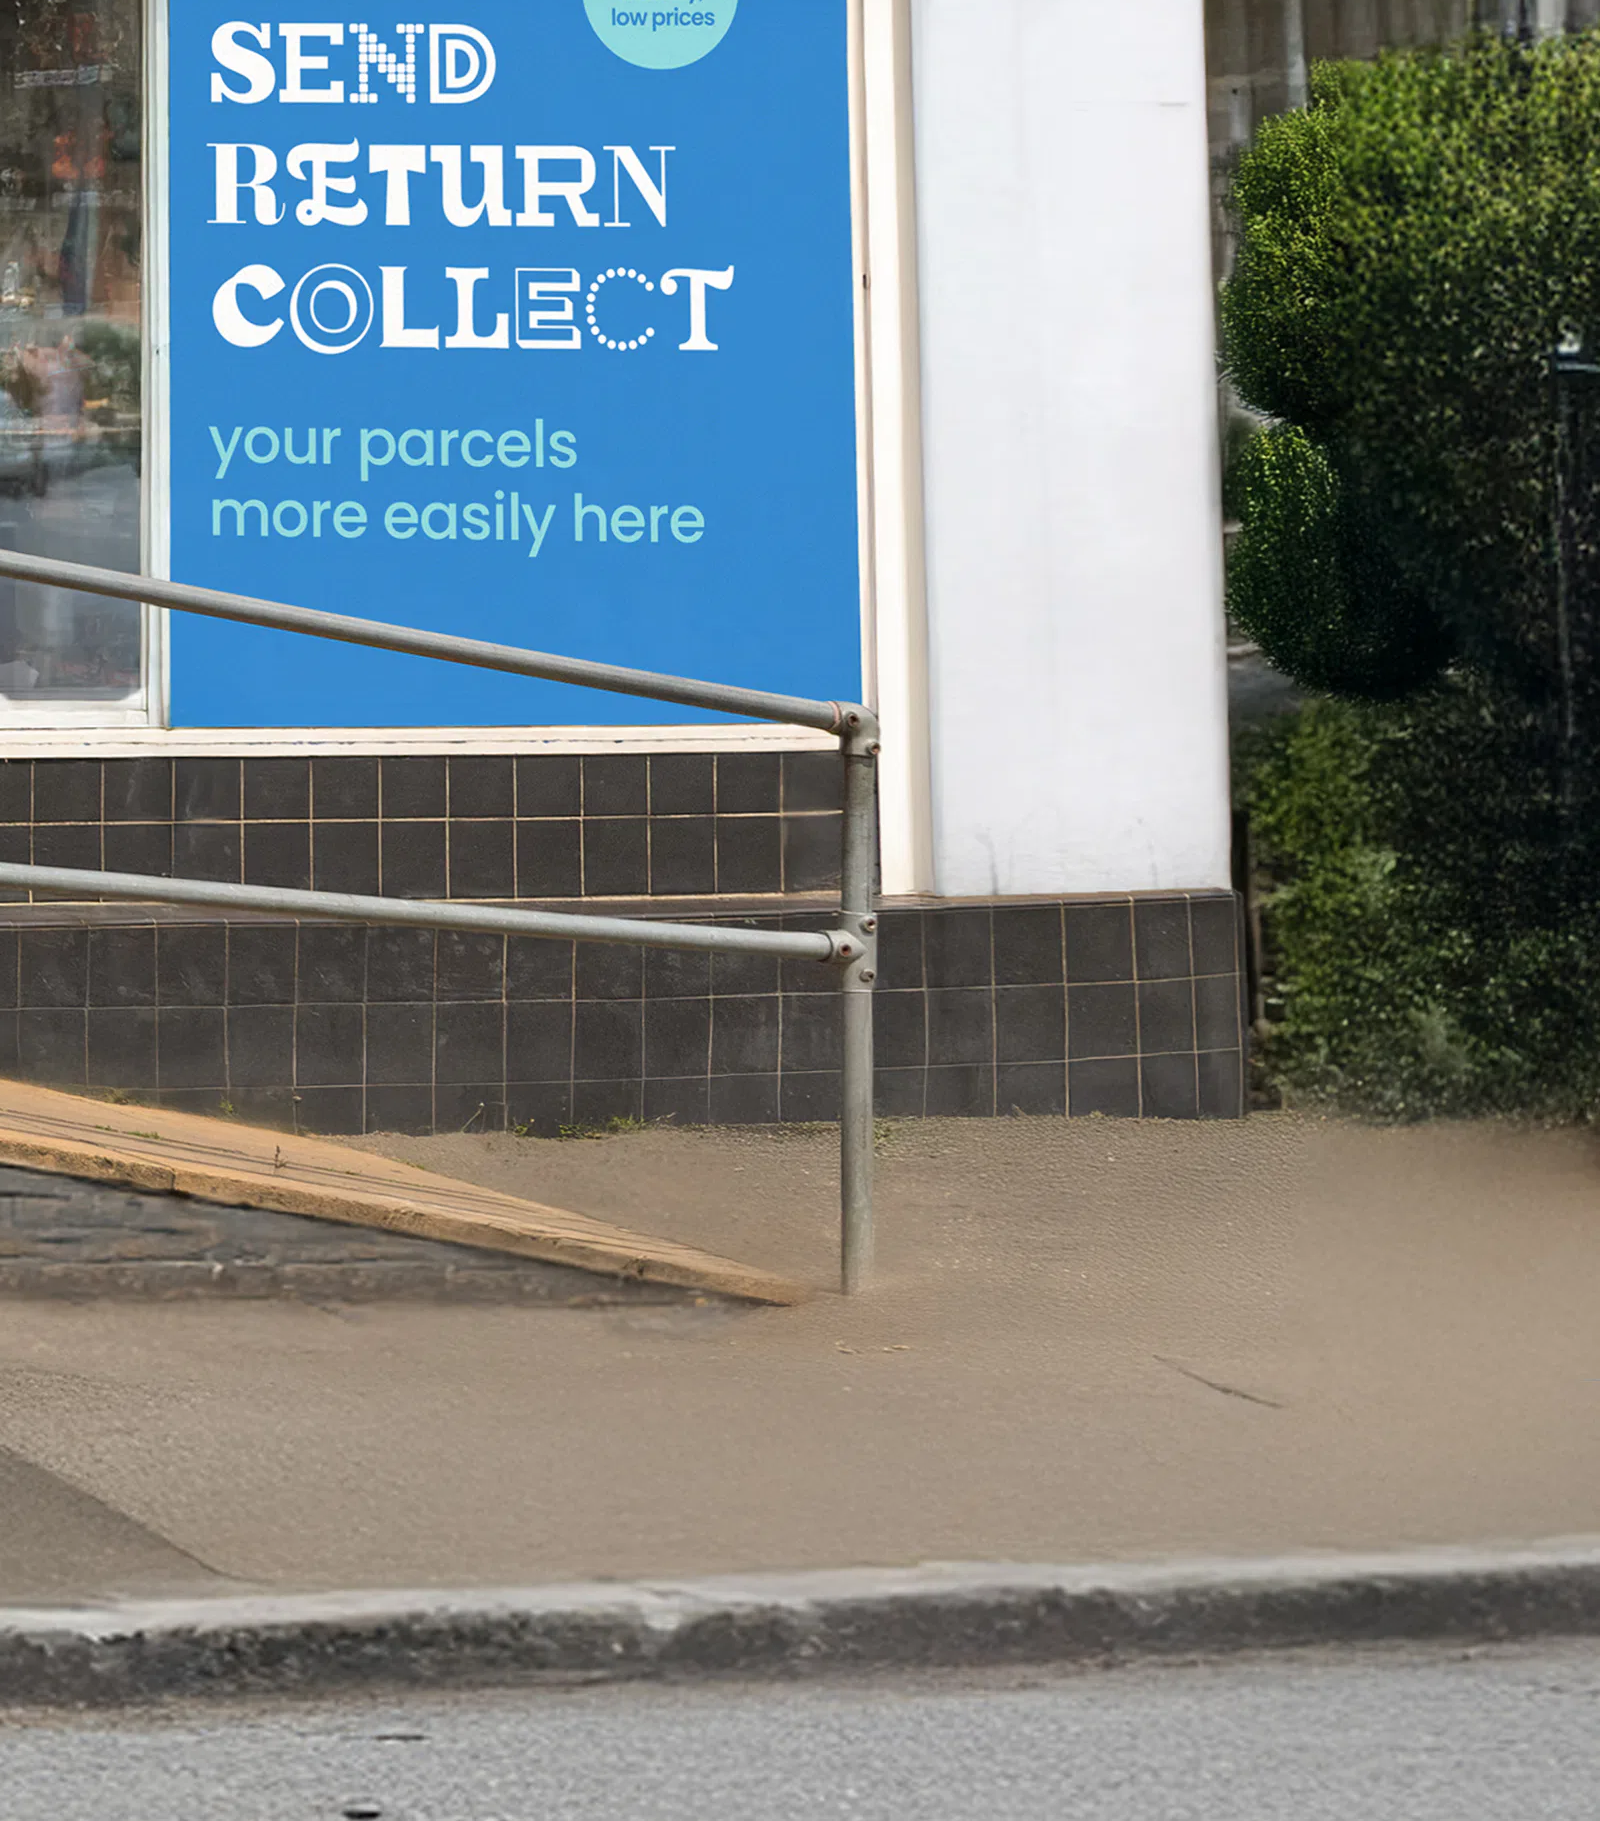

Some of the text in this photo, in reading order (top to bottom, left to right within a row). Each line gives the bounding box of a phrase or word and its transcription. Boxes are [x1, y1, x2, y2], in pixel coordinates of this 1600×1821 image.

[611, 7, 716, 32] low prices
[210, 20, 497, 105] SEND
[206, 137, 677, 228] RETURN
[212, 263, 735, 355] COLLECT
[208, 418, 578, 482] your parcels
[211, 490, 706, 559] more easily here
